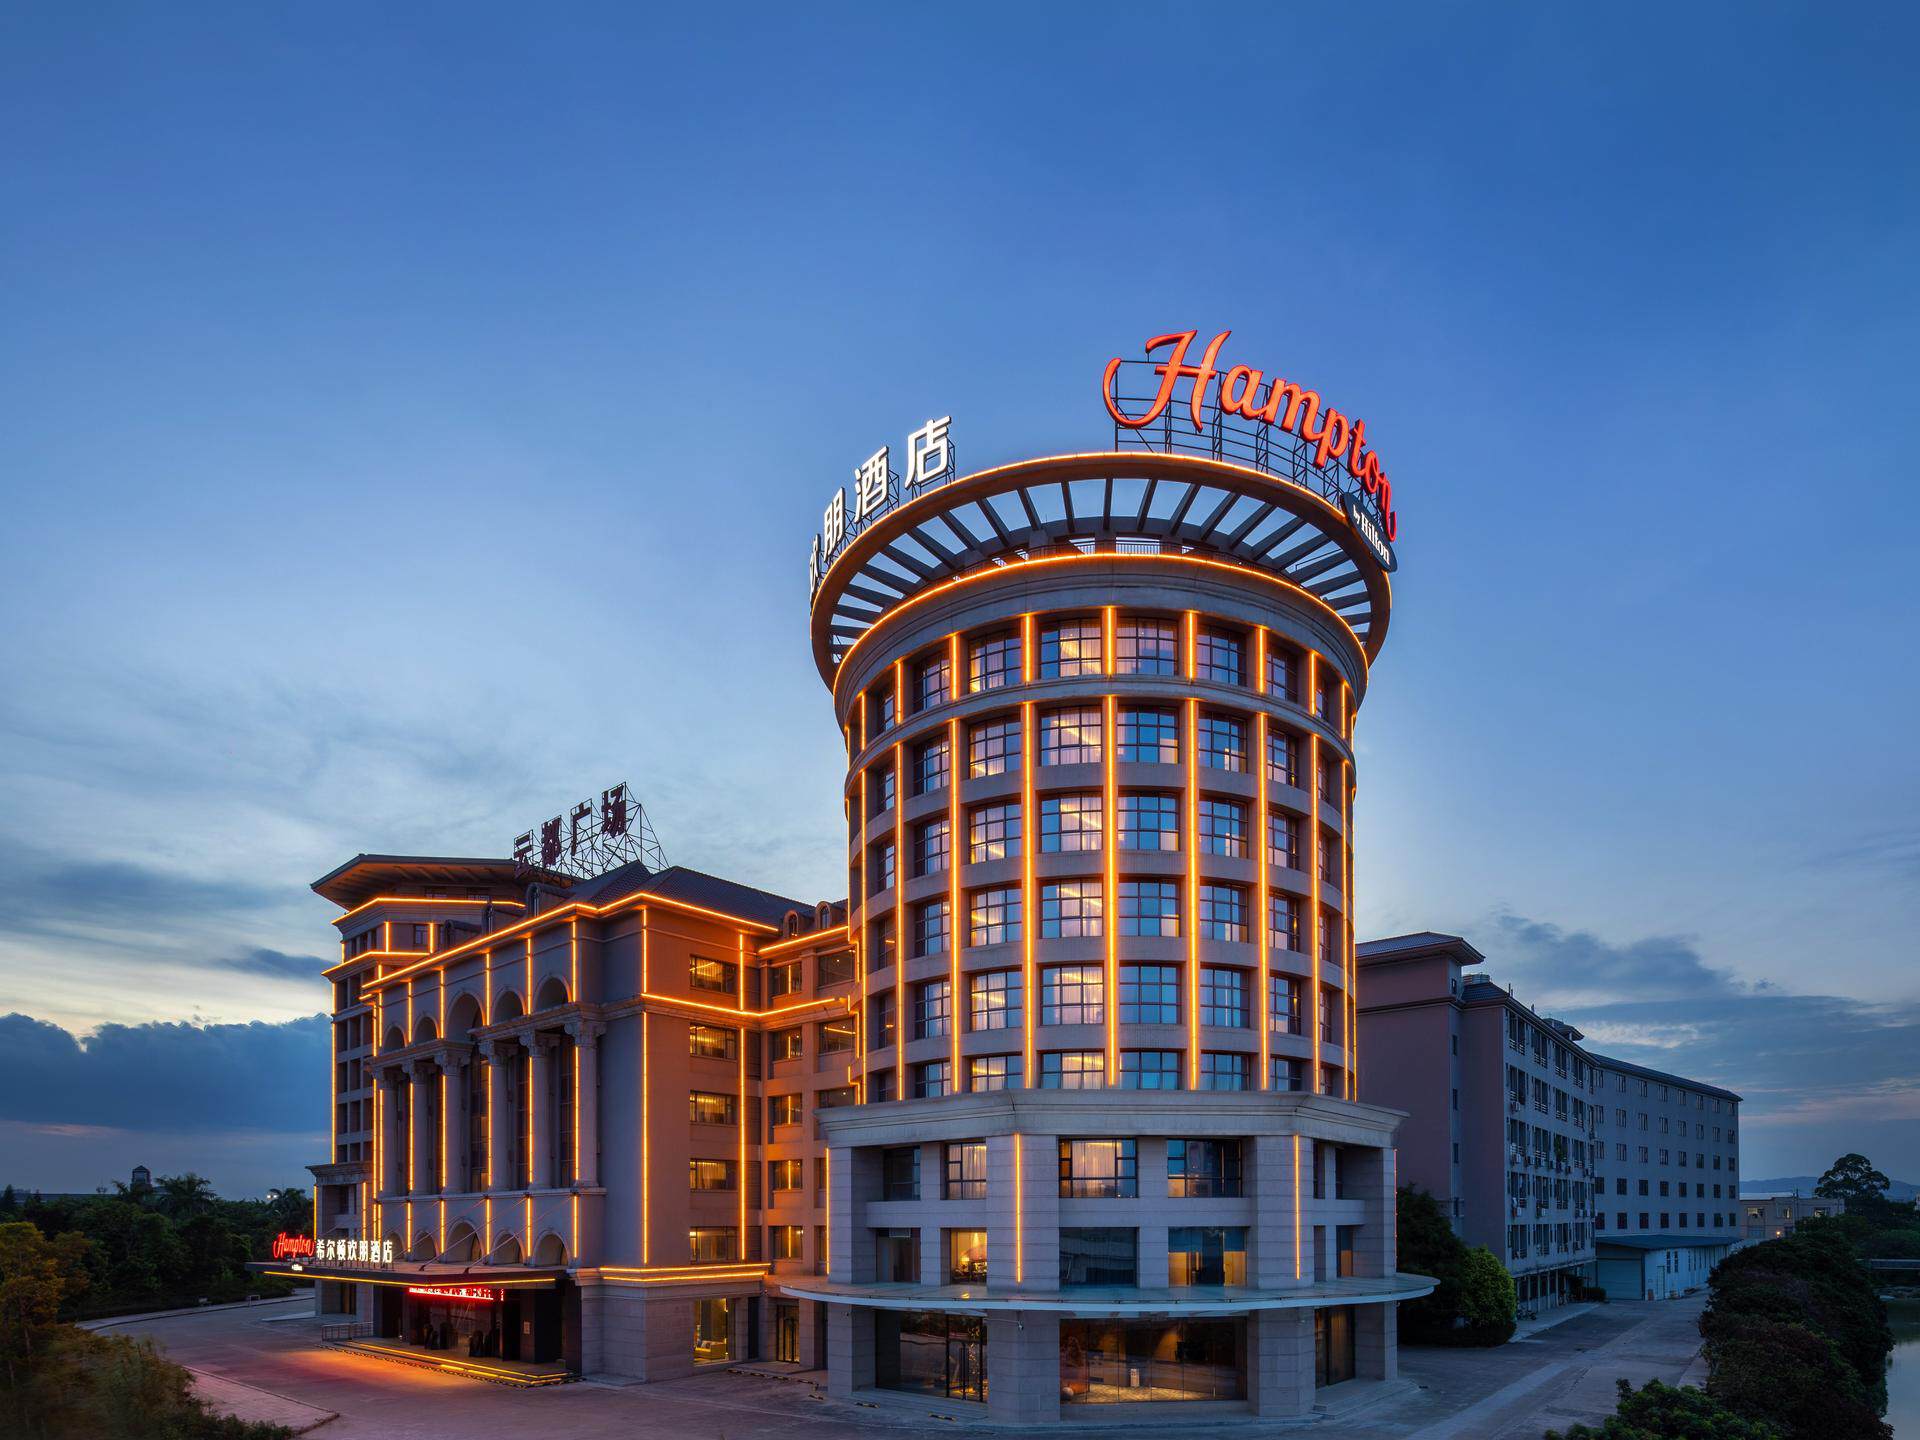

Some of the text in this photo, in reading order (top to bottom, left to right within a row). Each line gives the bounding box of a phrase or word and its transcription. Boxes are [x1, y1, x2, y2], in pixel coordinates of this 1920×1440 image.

[1103, 330, 1396, 541] Hampton
[1353, 504, 1390, 565] by Hilton
[273, 1231, 315, 1259] Hampton
[316, 1239, 393, 1263] 希尔顿欢朋酒店
